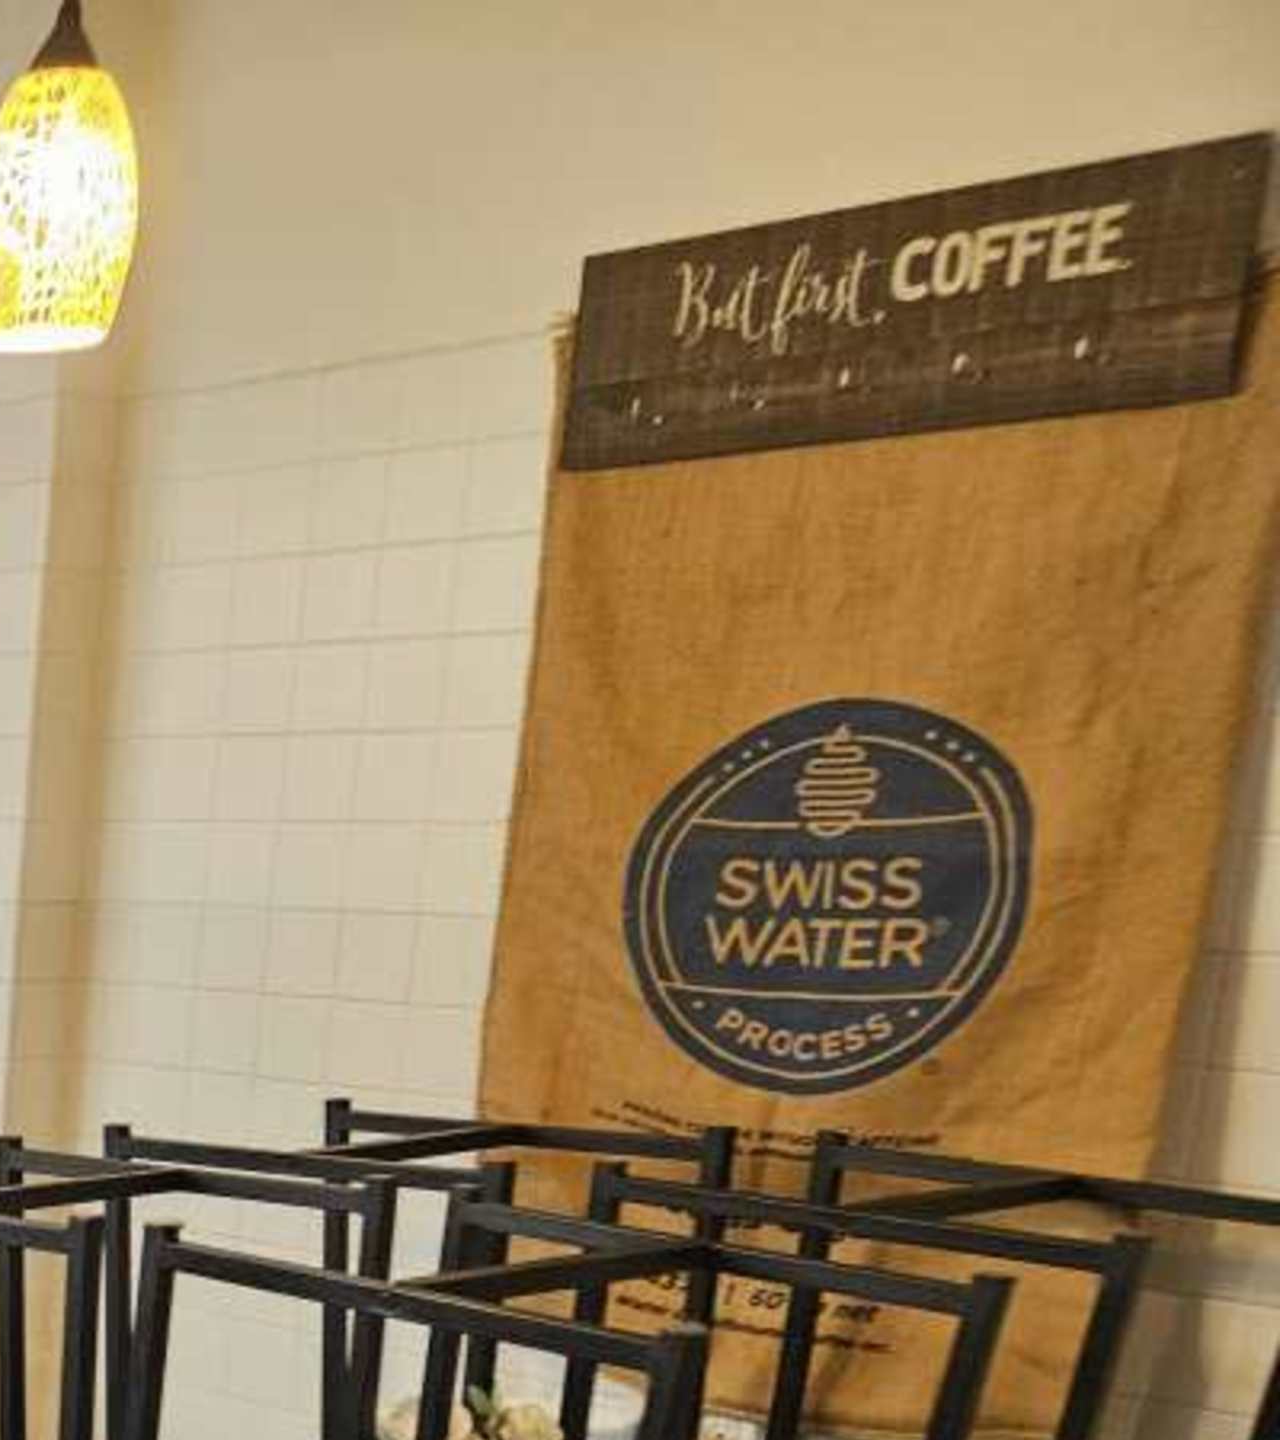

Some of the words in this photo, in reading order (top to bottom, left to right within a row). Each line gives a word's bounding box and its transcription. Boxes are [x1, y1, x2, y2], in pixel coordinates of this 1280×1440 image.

[672, 260, 770, 350] But
[889, 202, 1133, 302] COFFEE
[714, 856, 924, 911] SWISS
[704, 914, 929, 969] WATER
[715, 1007, 893, 1062] PROCESS
